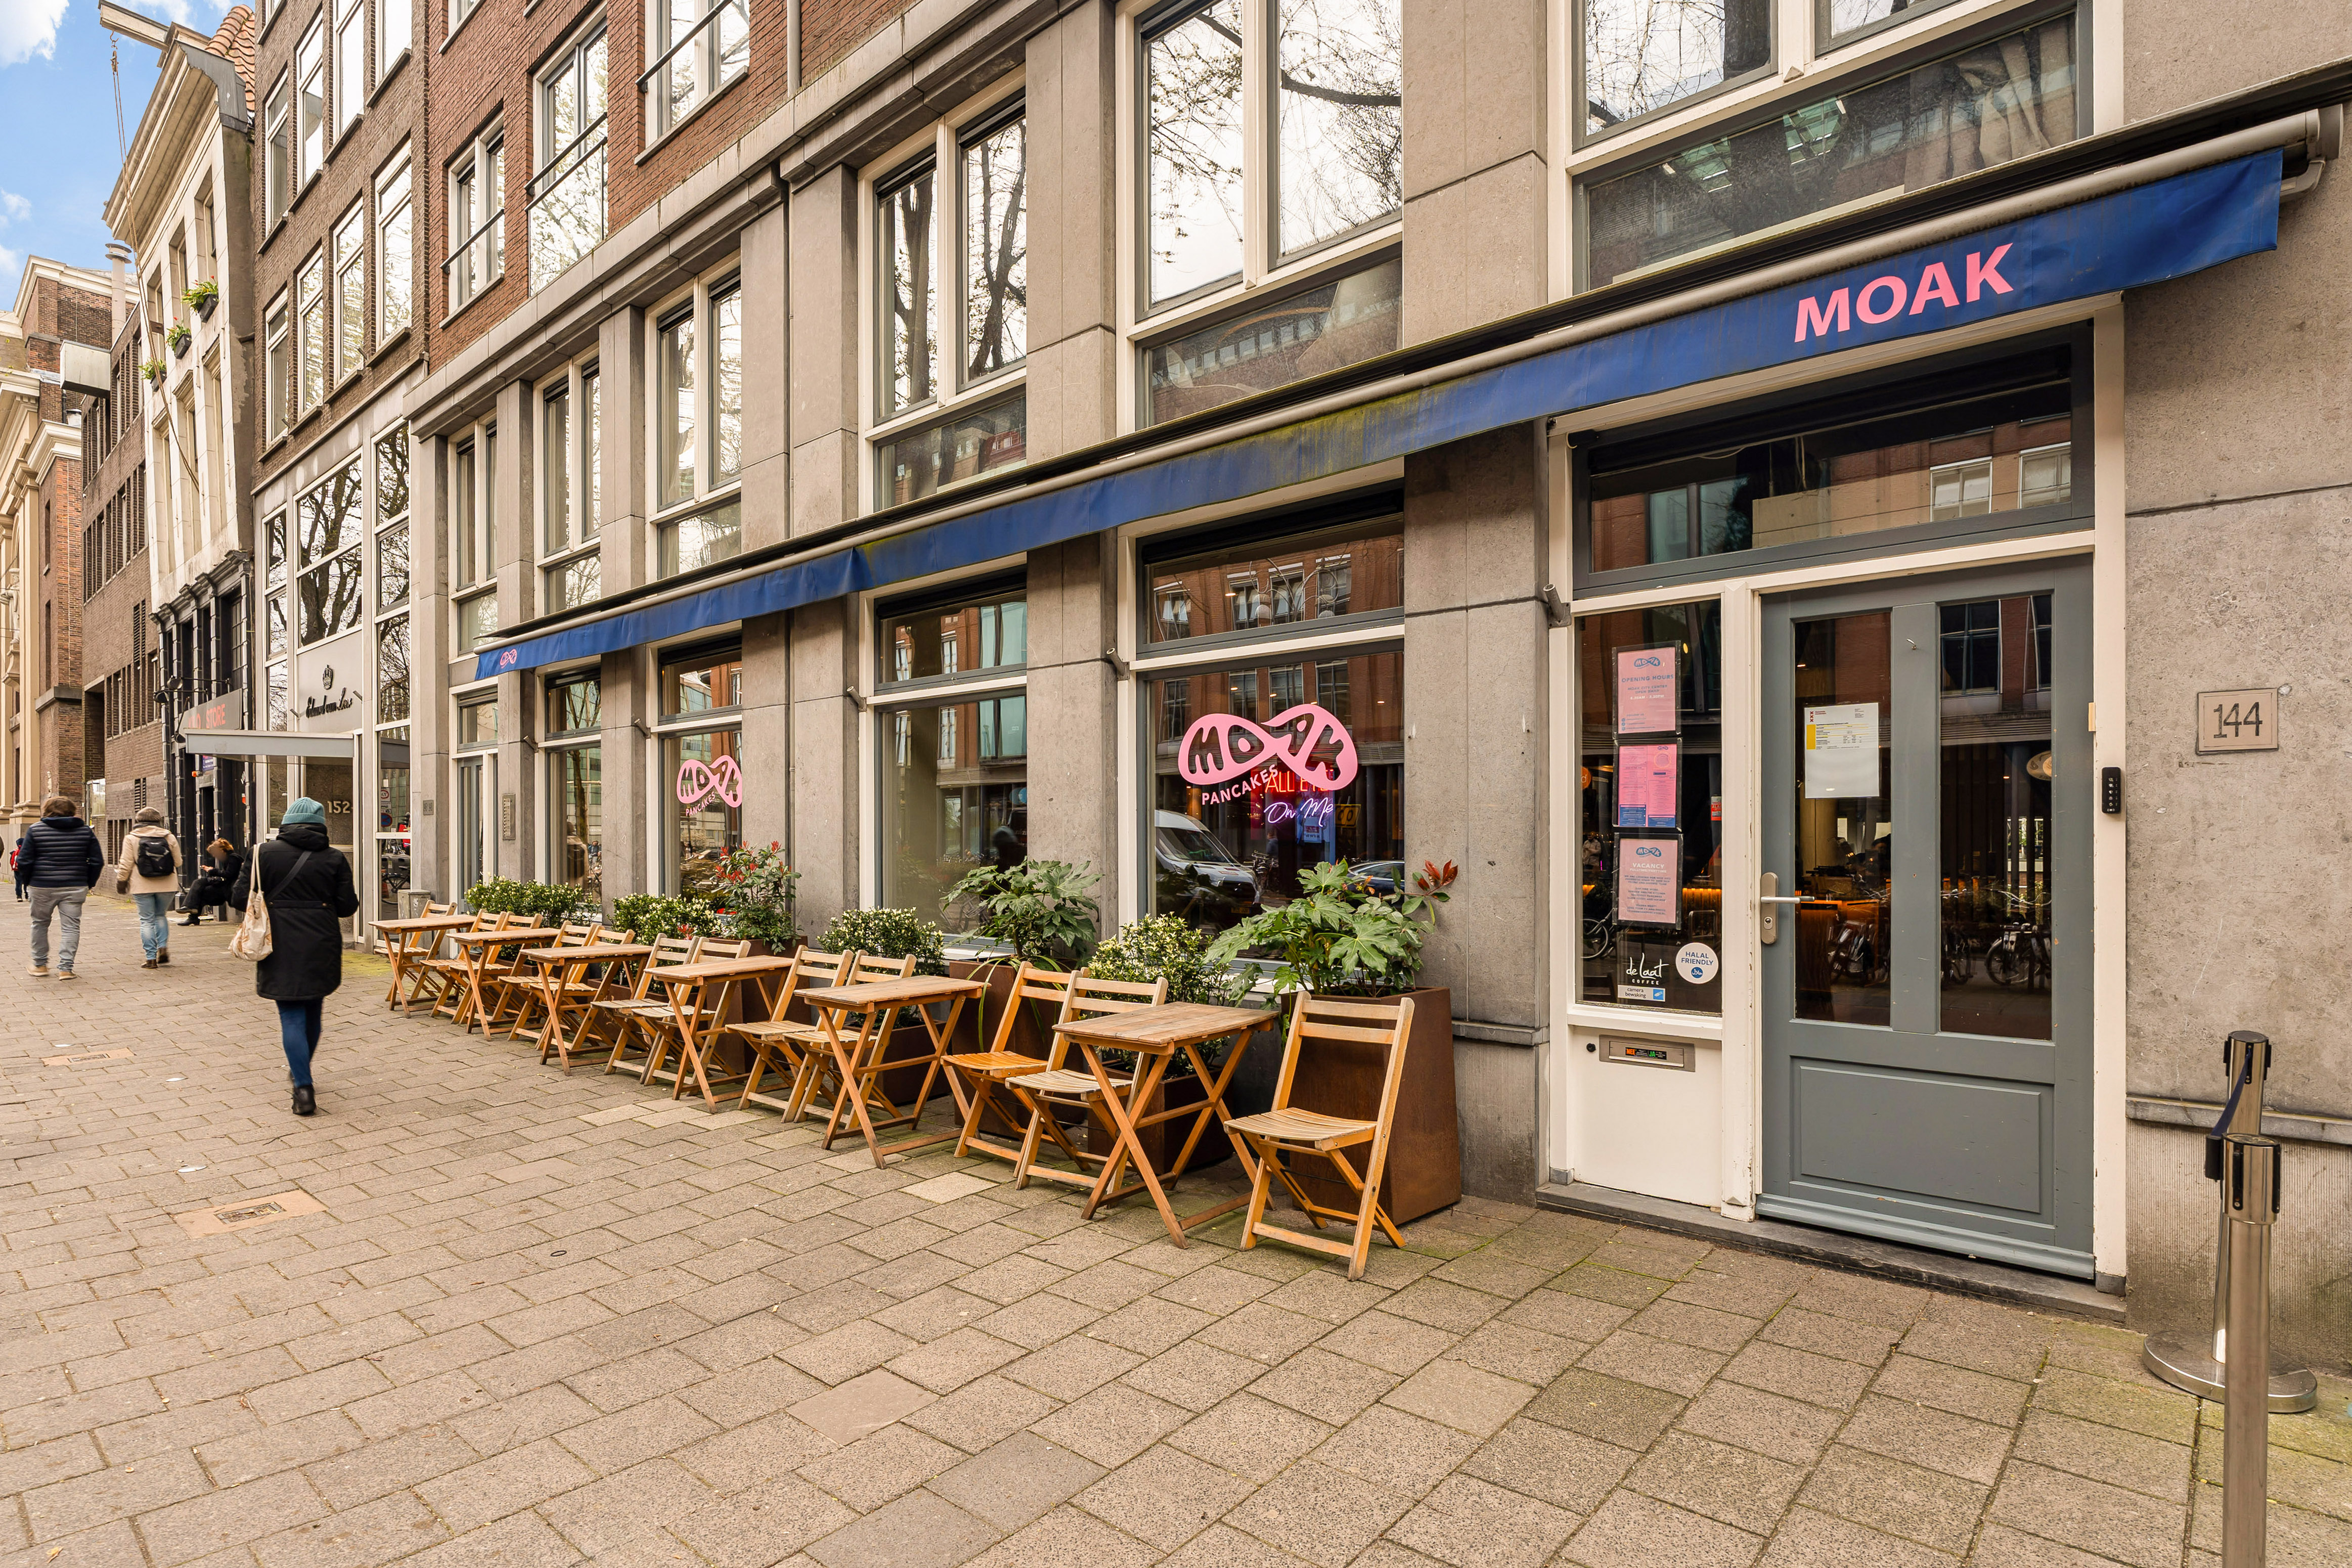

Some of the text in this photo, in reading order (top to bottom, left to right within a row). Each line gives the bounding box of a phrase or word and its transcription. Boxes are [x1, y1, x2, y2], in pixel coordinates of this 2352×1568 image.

[1794, 243, 2014, 342] MOAK
[206, 703, 226, 729] STORE
[2213, 701, 2263, 739] 144
[1181, 707, 1353, 787] MOAK
[678, 757, 741, 805] MOAK
[1202, 764, 1278, 805] PANCAKES
[1265, 771, 1295, 793] ALL
[685, 791, 716, 816] PANCAKES
[1264, 801, 1297, 824] On
[1300, 797, 1334, 827] Me
[1626, 957, 1638, 976] de
[1681, 958, 1713, 966] FRIENDLY
